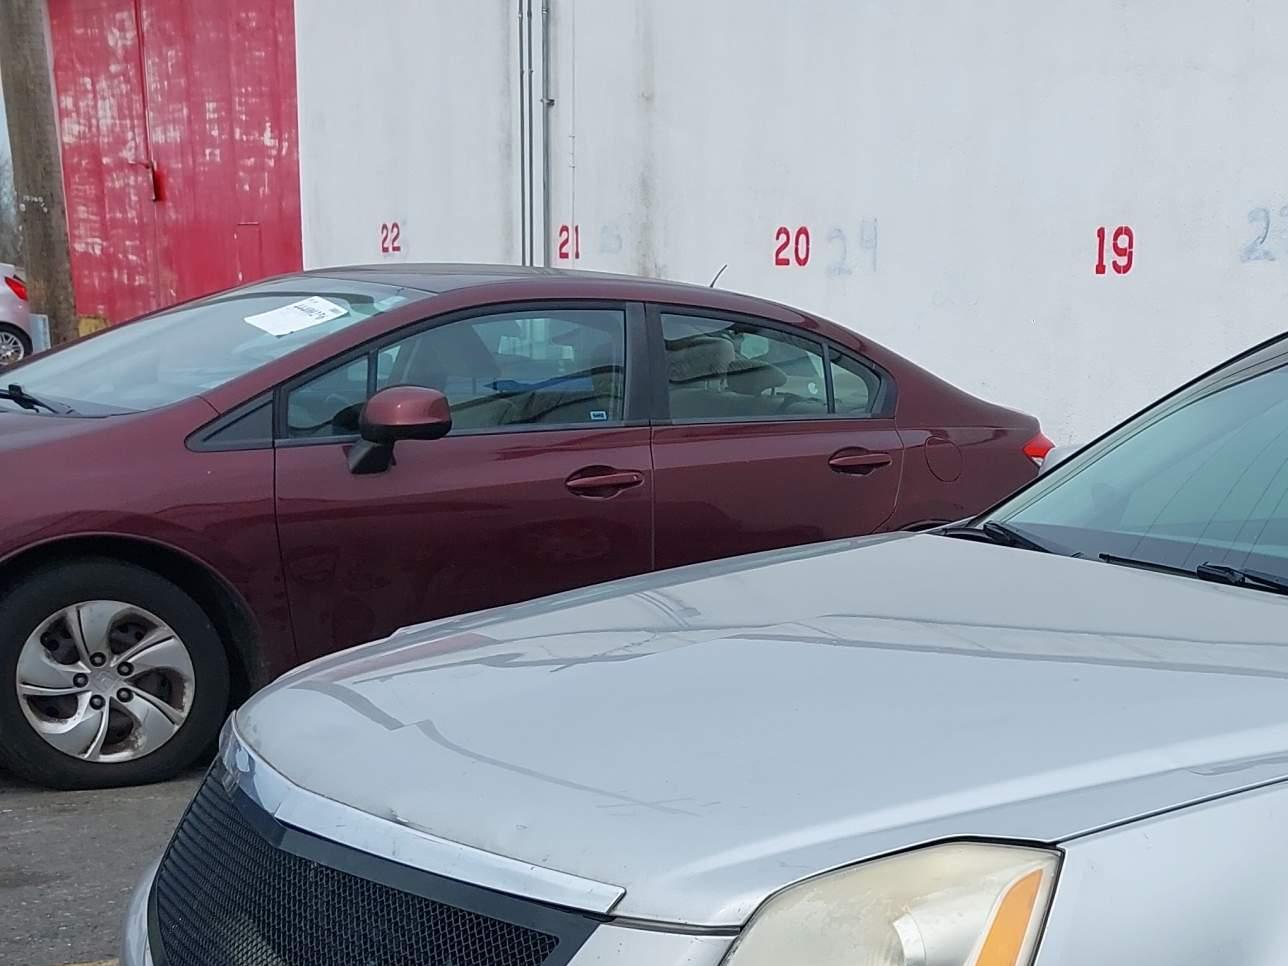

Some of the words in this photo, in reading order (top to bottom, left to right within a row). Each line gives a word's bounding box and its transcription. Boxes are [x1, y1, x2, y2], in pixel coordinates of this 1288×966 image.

[381, 223, 401, 252] 22
[558, 224, 580, 259] 21
[774, 226, 811, 267] 20
[1095, 226, 1134, 275] 19
